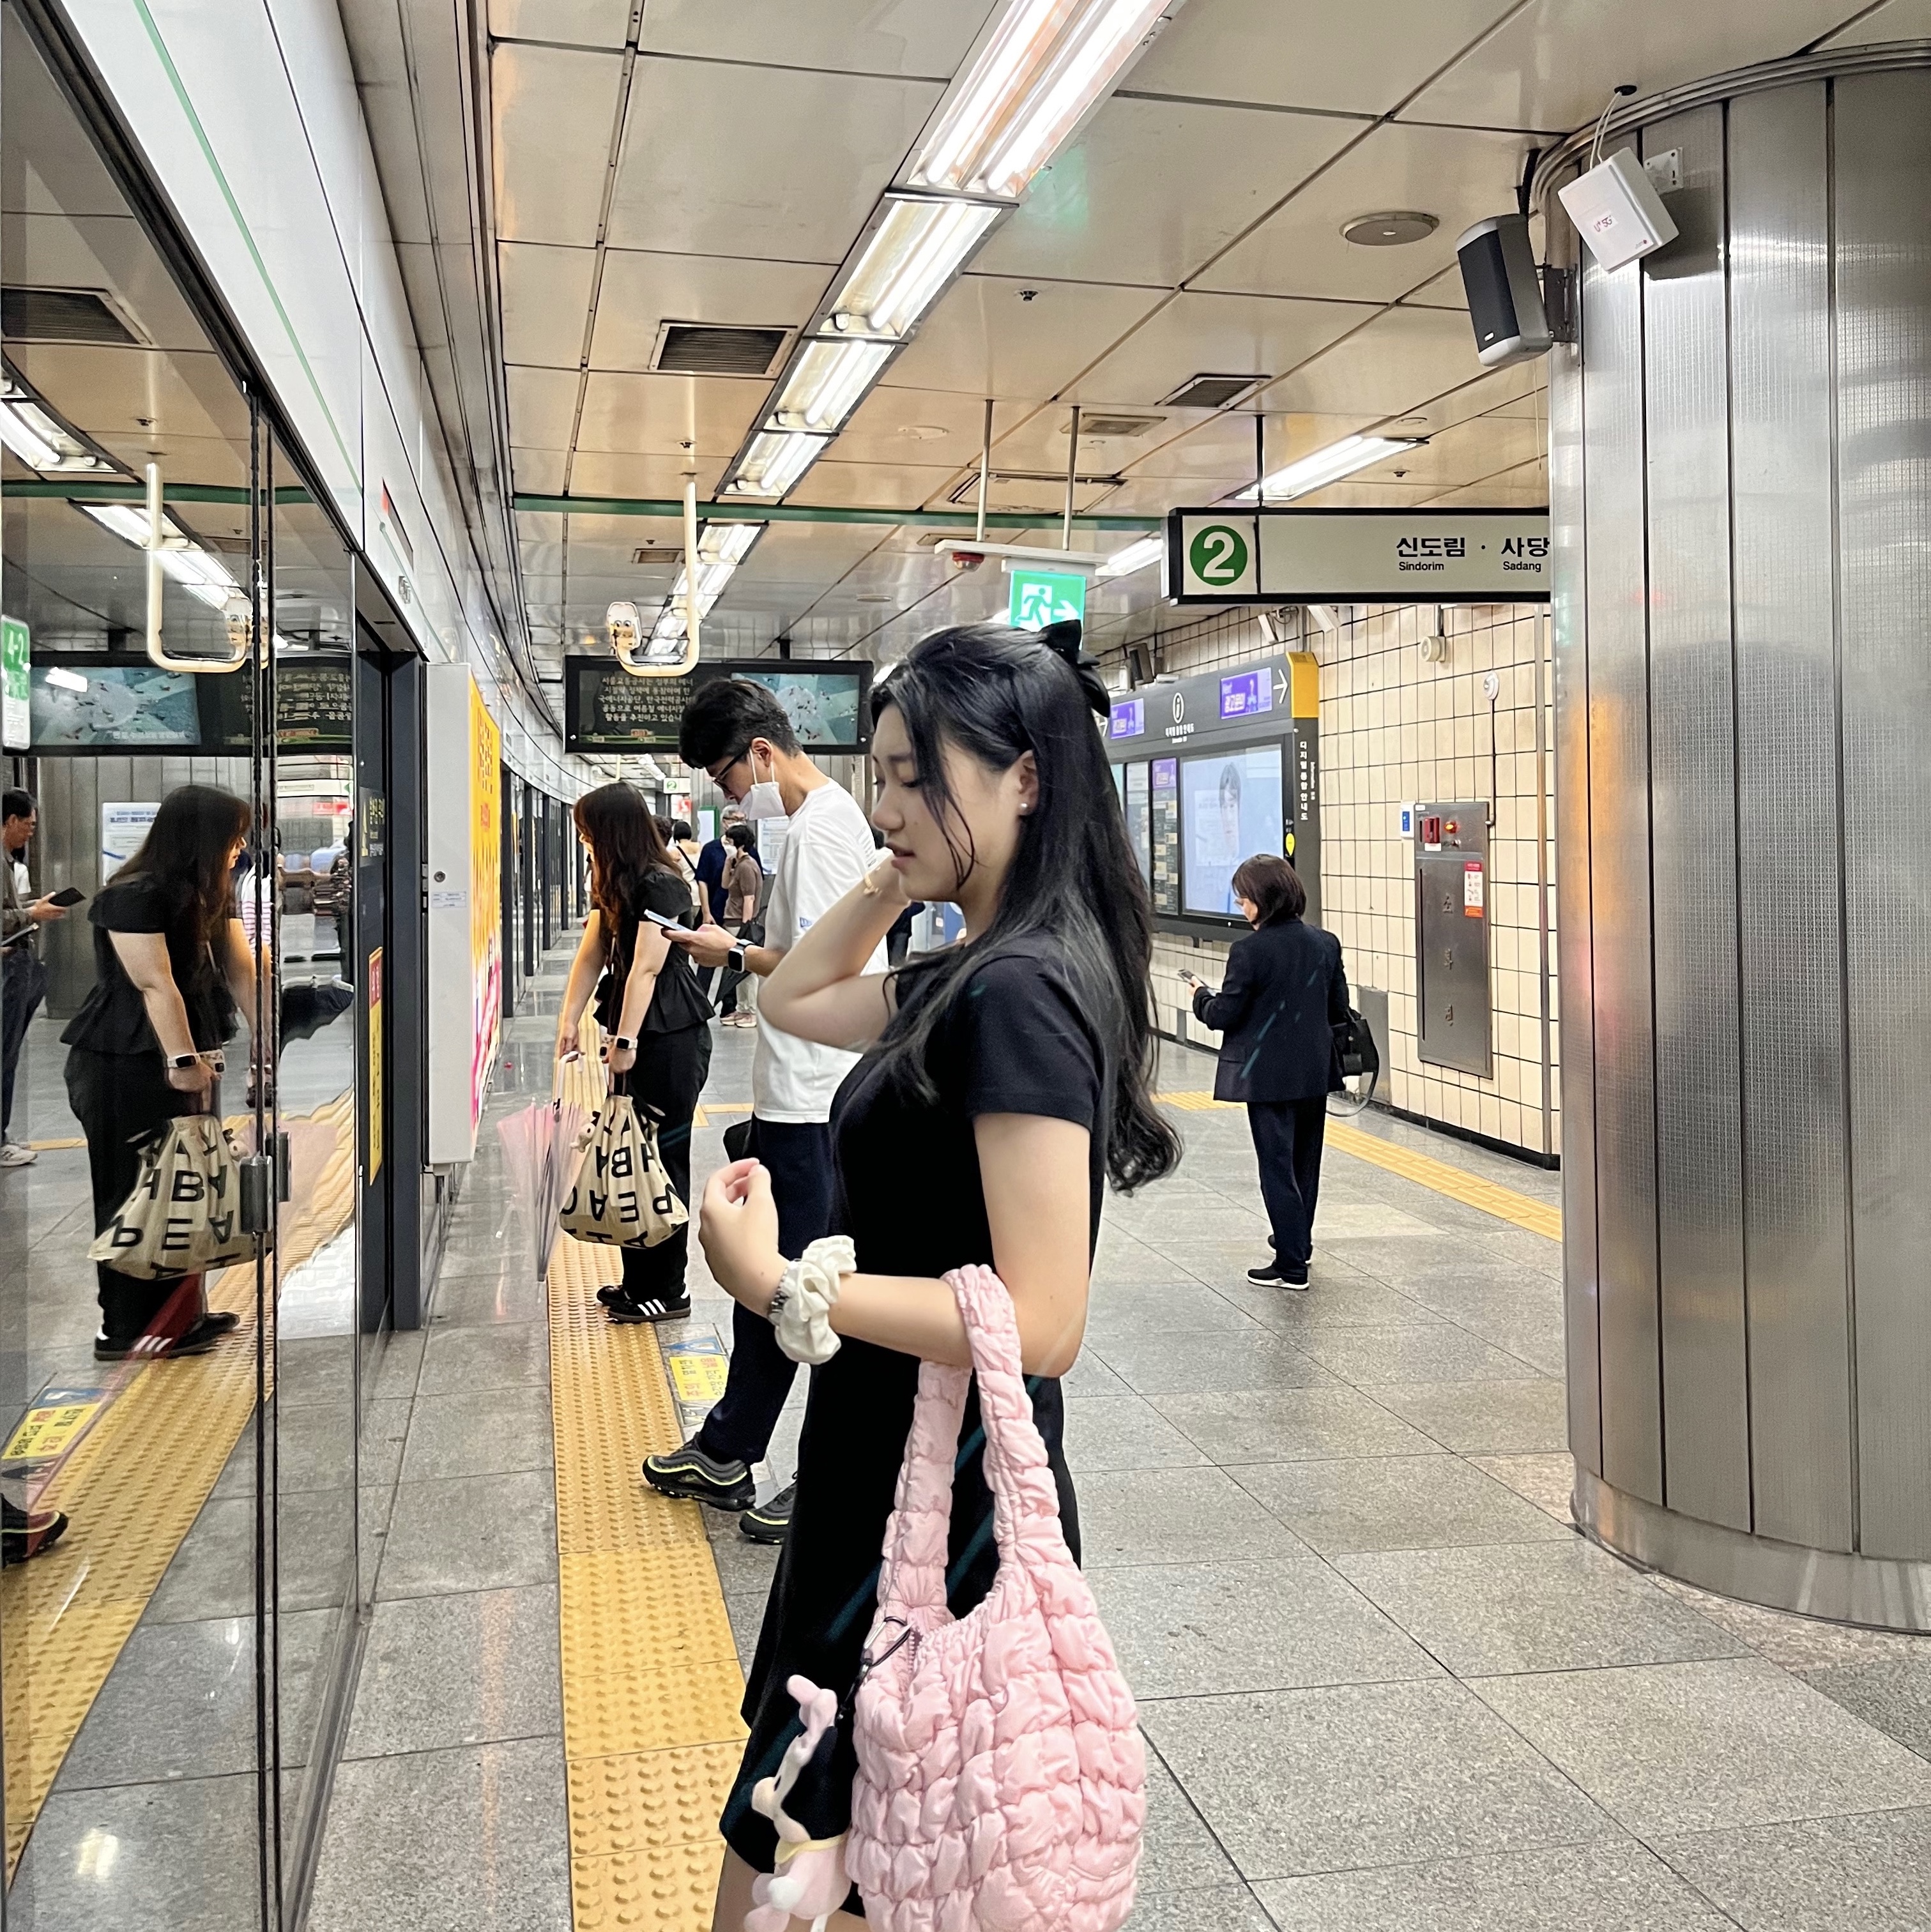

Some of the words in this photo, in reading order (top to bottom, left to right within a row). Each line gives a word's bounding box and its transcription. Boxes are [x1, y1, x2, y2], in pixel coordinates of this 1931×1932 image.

[1203, 531, 1235, 577] 2
[1396, 537, 1465, 558] 신도림
[1501, 537, 1550, 558] 사당
[1398, 561, 1445, 571] Sindorim
[1502, 561, 1541, 573] Sadang
